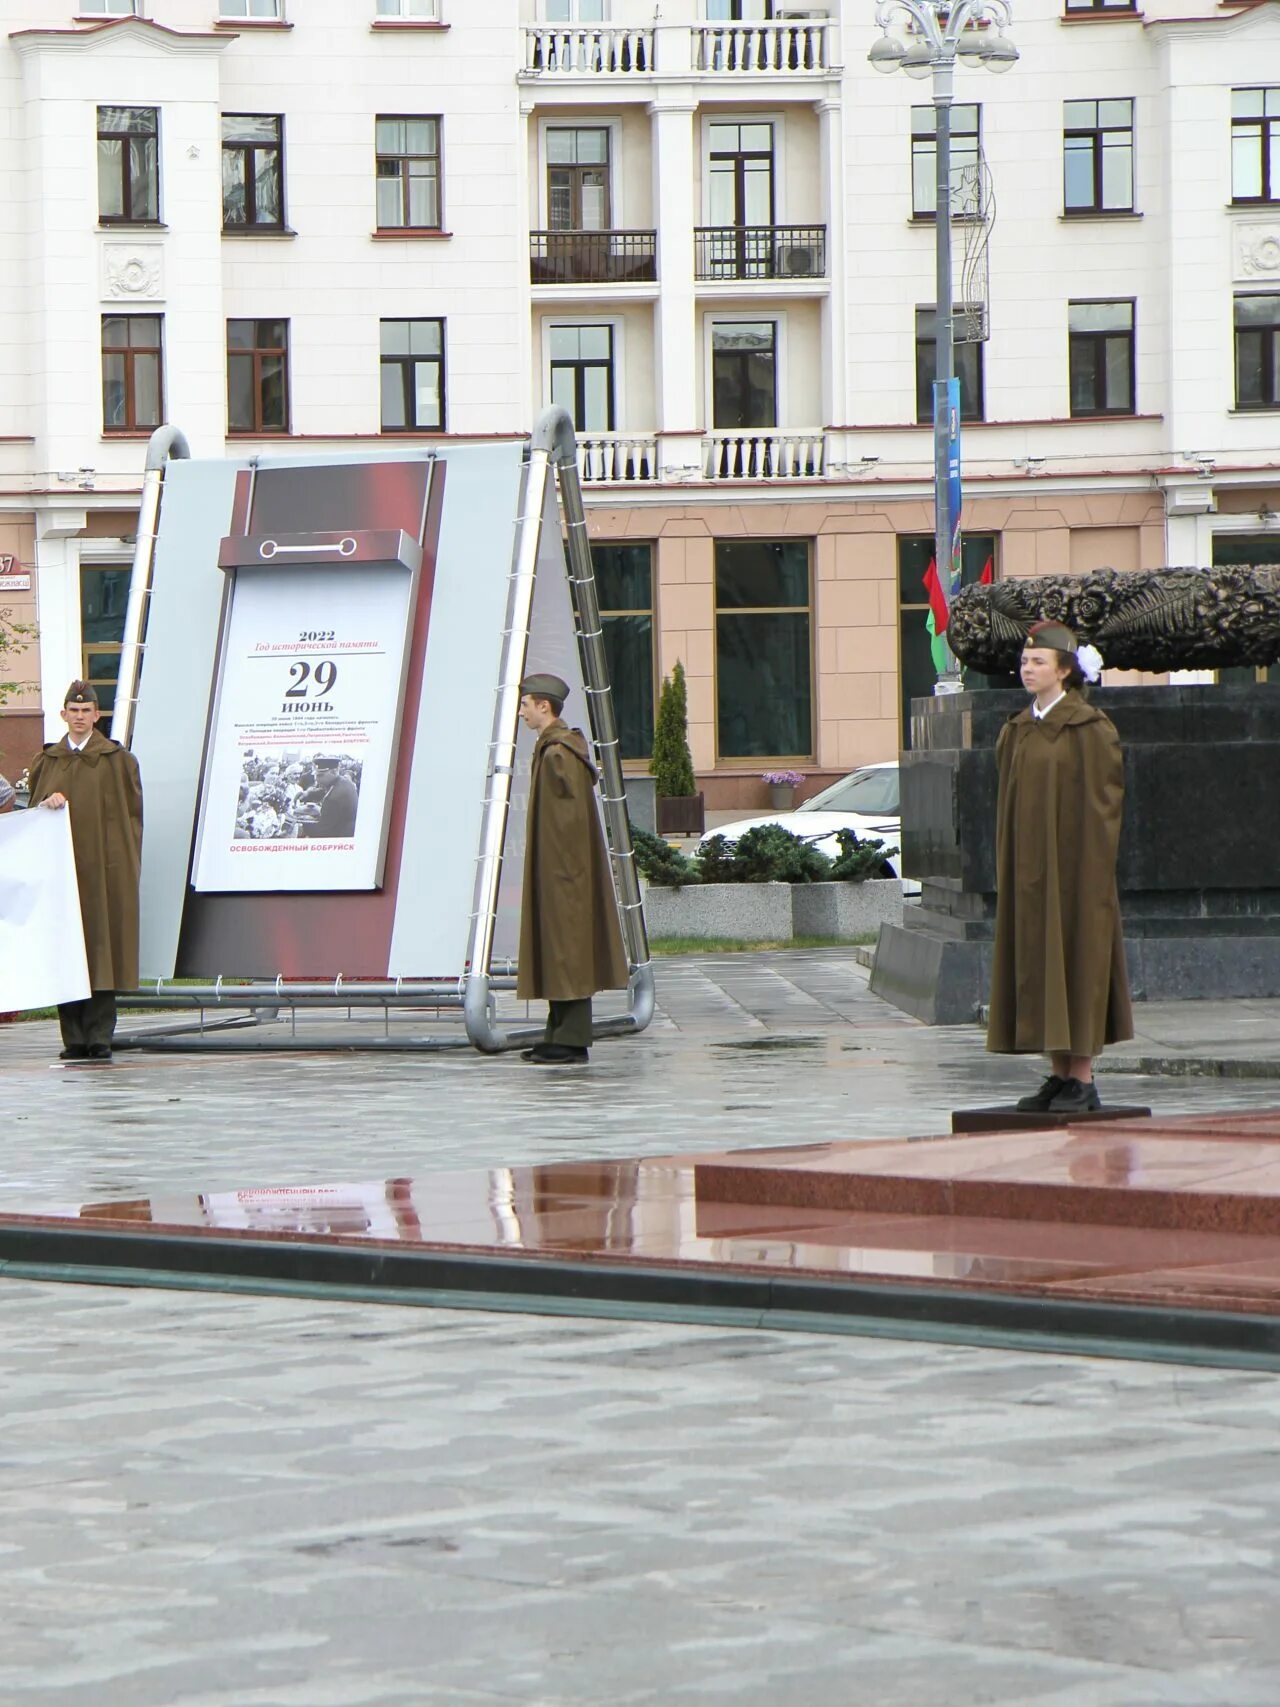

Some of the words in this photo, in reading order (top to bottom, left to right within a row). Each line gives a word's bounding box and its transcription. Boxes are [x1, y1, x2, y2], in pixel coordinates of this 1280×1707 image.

[299, 630, 335, 642] 2022
[255, 642, 270, 652] Год
[272, 640, 337, 652] исторической
[340, 640, 378, 649] памяти
[284, 660, 337, 698] 29
[229, 844, 309, 853] ОСВОБОЖДЕННЫЙ
[310, 843, 355, 851] БОБРУЙСК
